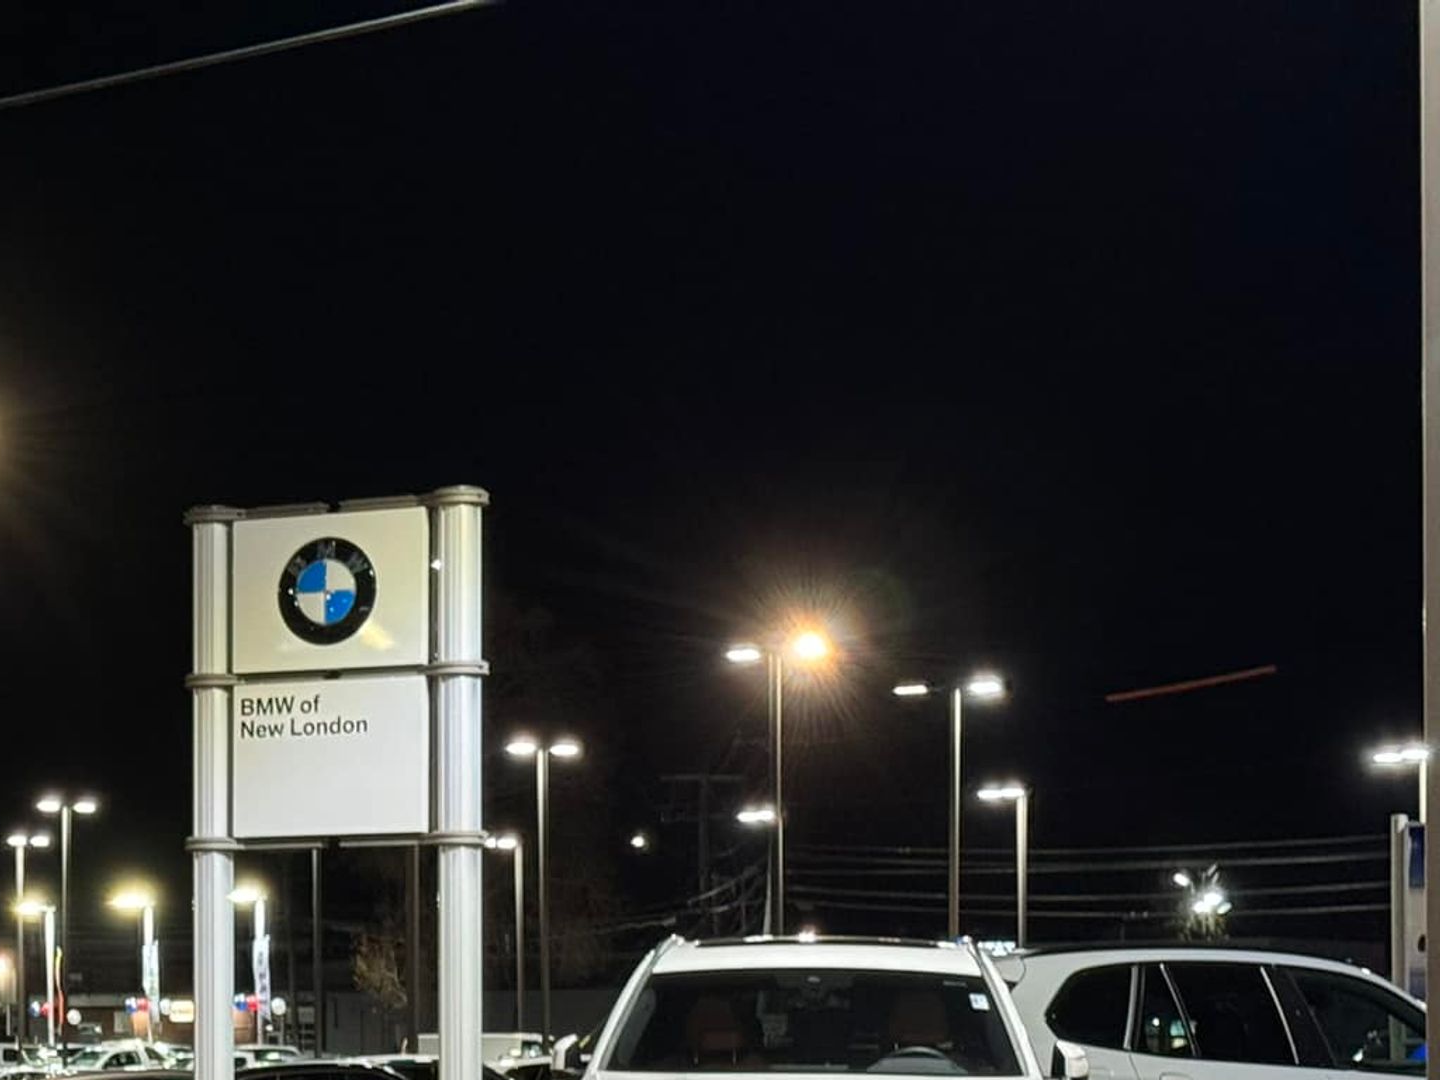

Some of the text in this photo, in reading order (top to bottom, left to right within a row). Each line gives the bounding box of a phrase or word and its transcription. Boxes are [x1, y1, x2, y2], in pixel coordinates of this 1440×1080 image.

[241, 694, 320, 716] BMW of
[241, 715, 368, 739] New London
